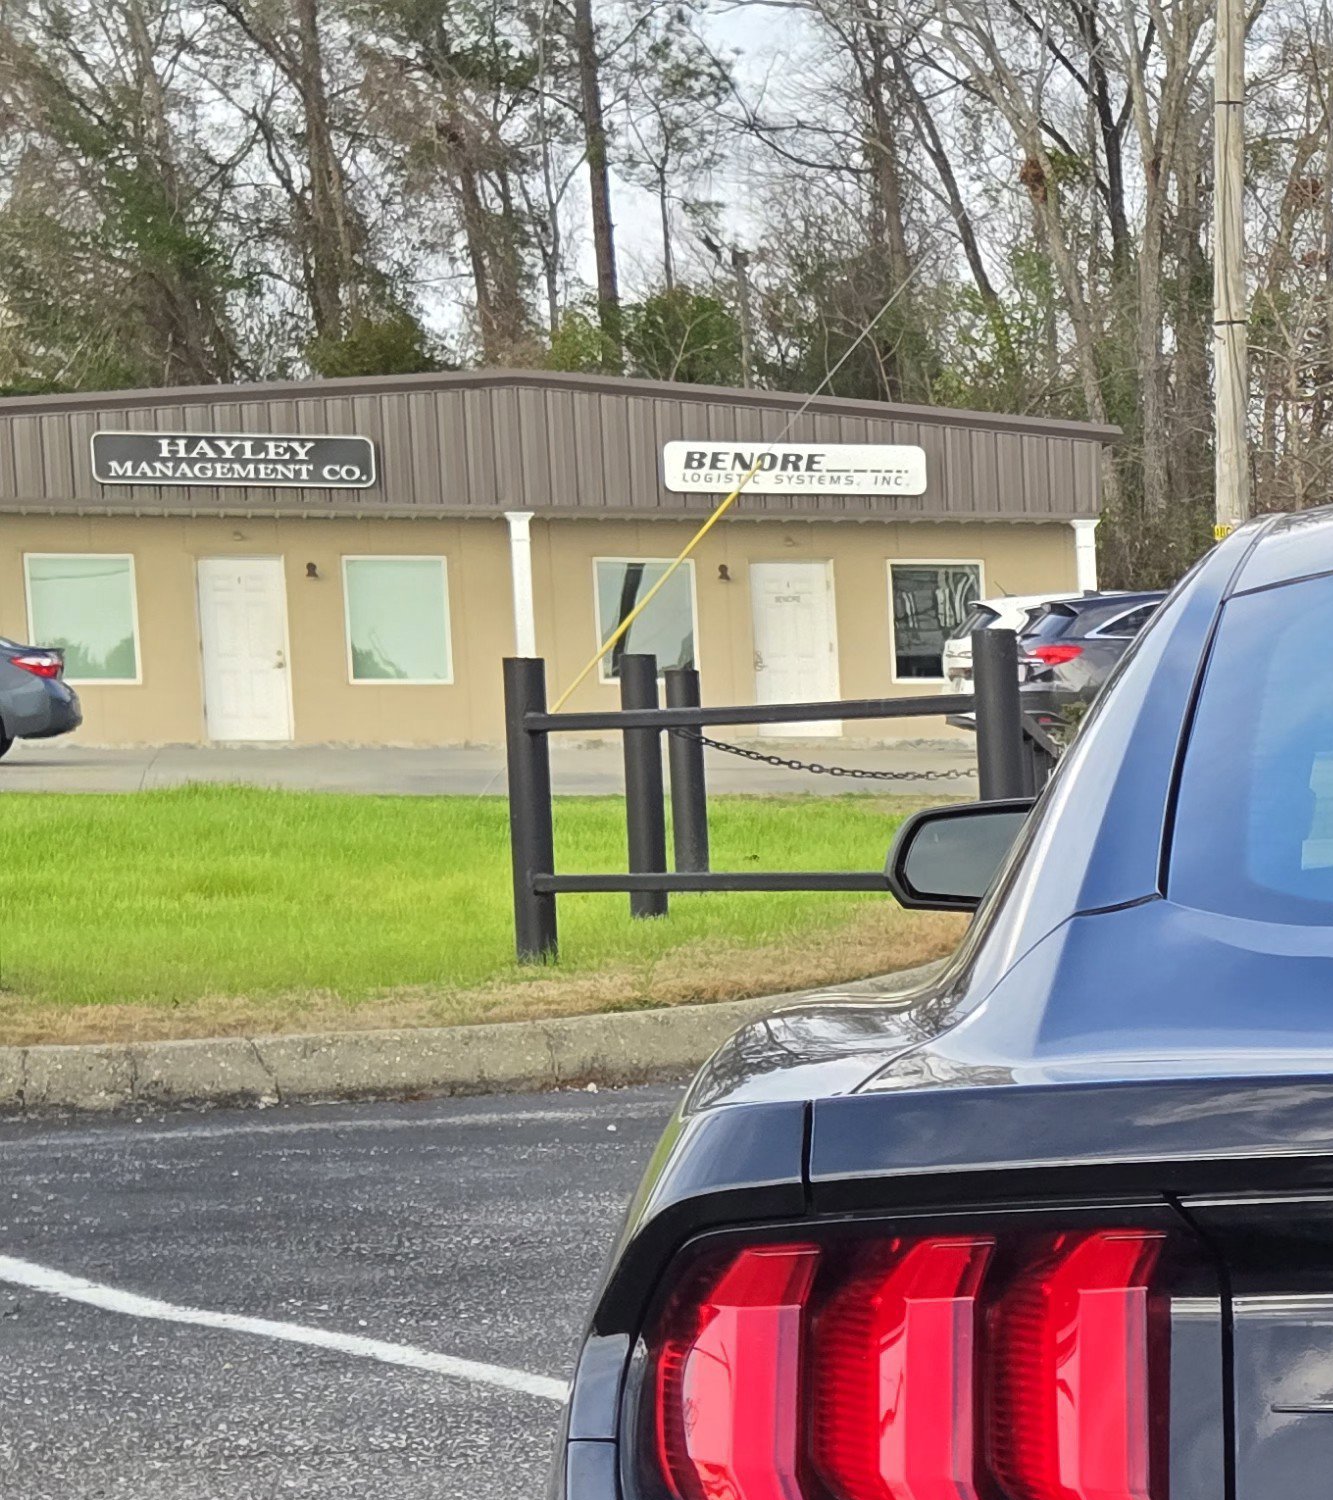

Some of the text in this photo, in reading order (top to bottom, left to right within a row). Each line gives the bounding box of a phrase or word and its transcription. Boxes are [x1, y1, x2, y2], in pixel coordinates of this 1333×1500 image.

[158, 438, 316, 460] HAYLEY
[107, 460, 368, 482] MANAGEMENT CO.
[683, 450, 827, 473] BENORE
[681, 473, 761, 485] LOGISTC
[873, 475, 911, 487] INC.
